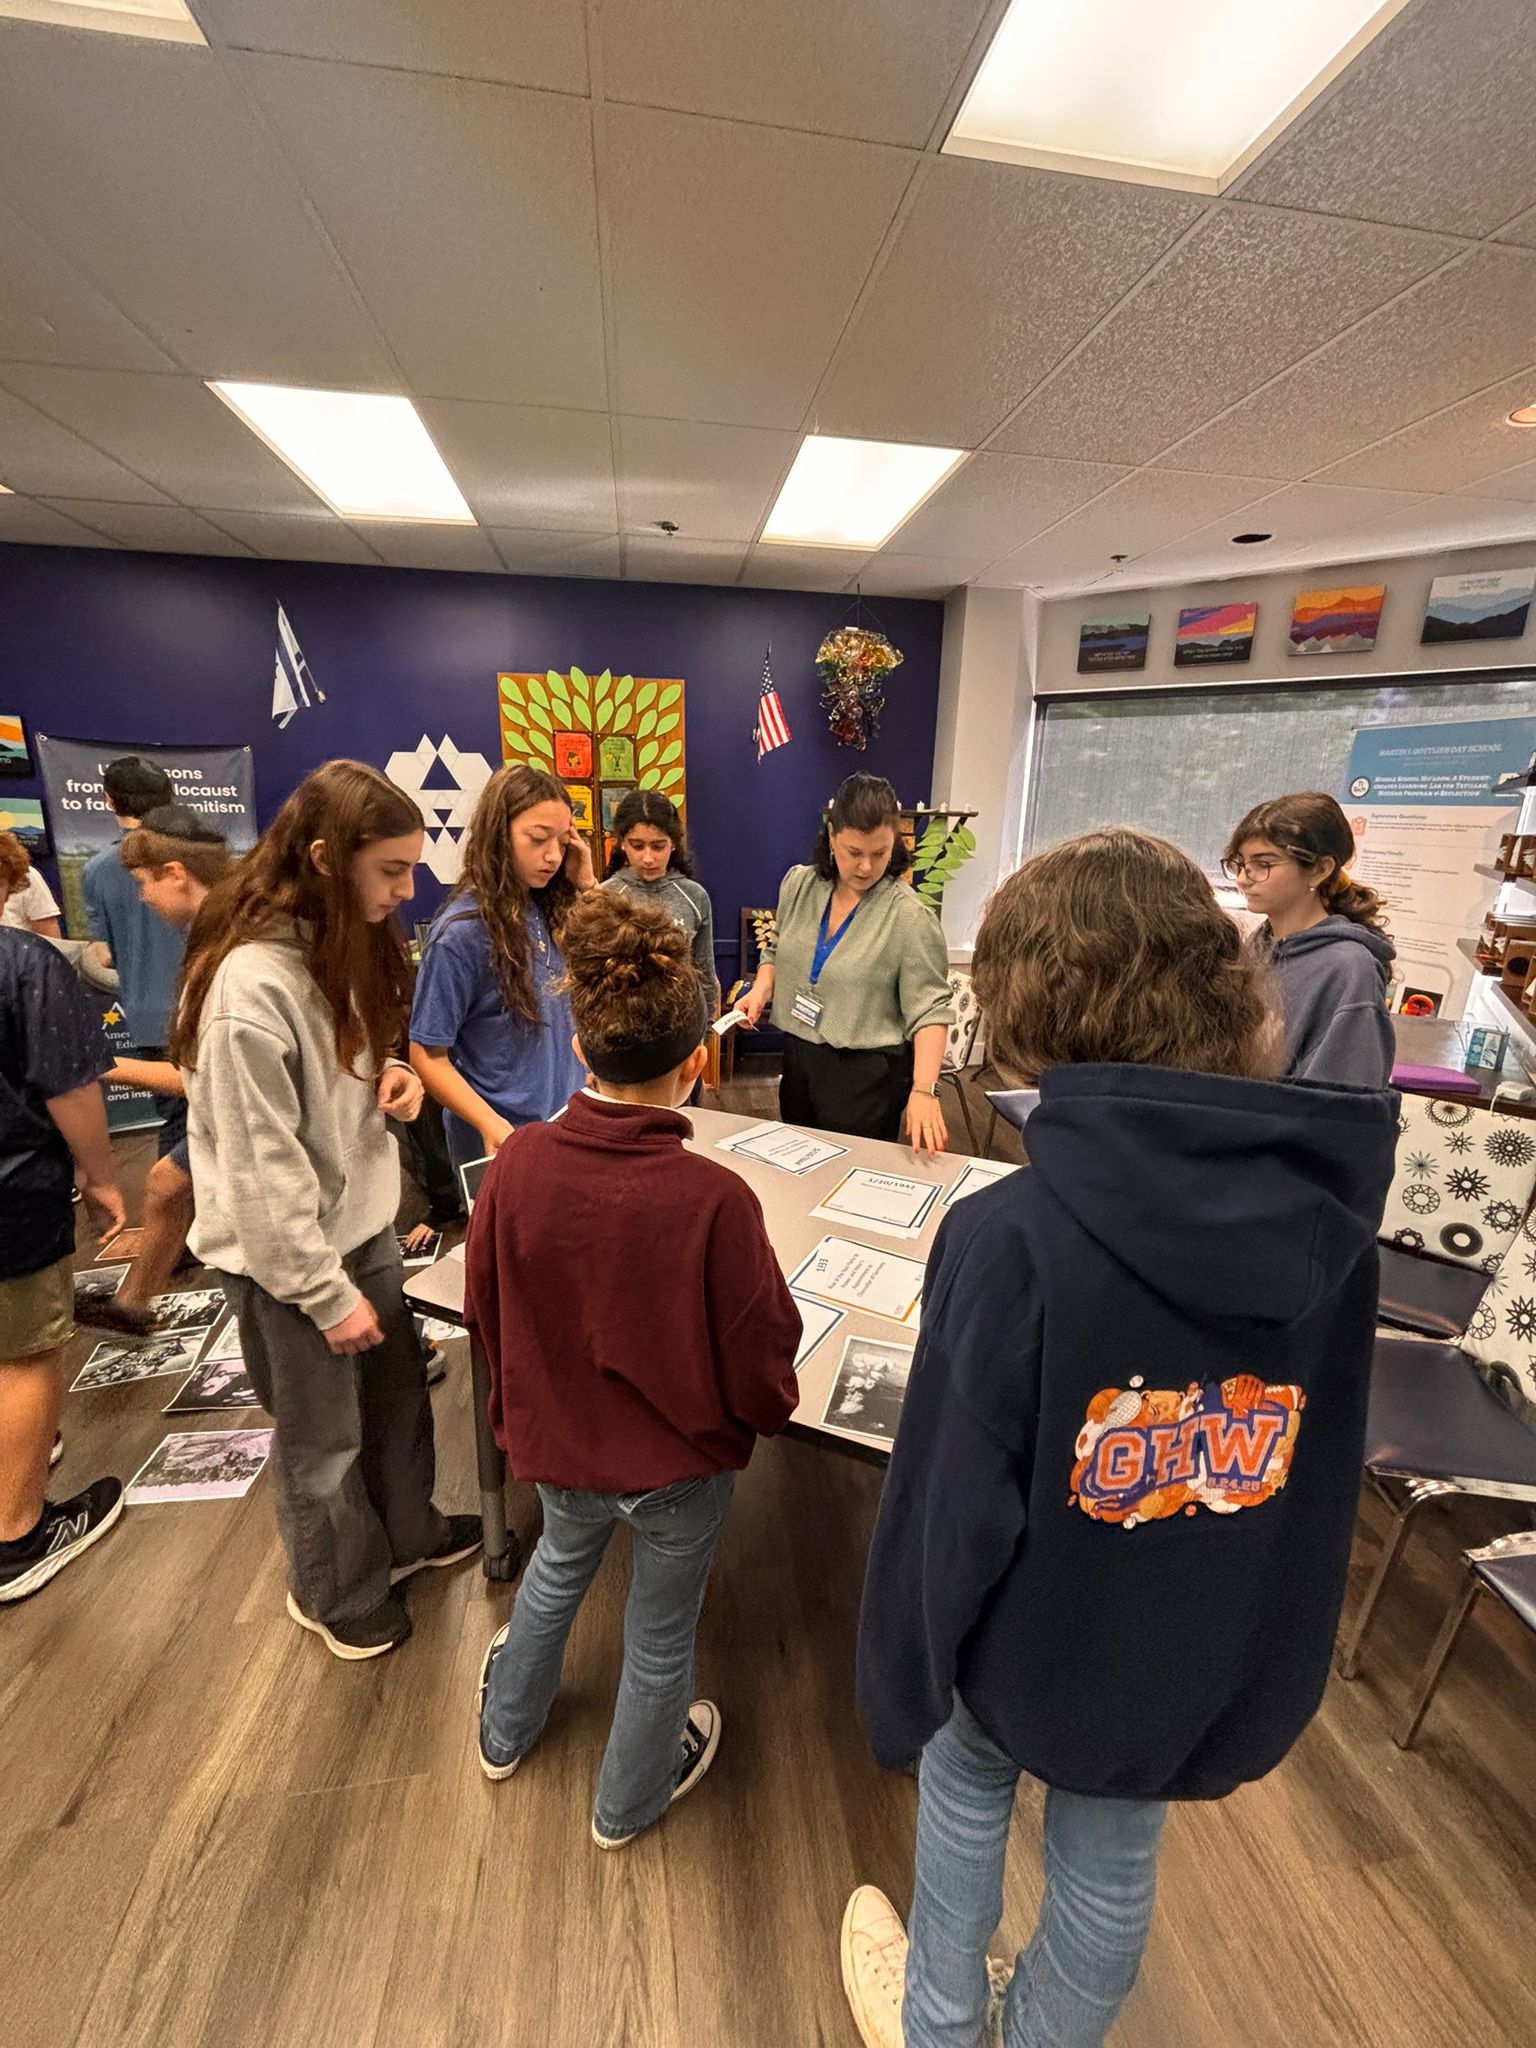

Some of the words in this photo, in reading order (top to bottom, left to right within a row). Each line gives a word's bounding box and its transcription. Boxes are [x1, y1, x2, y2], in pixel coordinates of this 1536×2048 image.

[1467, 743, 1502, 753] SCHOOL
[174, 783, 238, 797] locaust
[61, 797, 82, 811] to
[107, 1091, 130, 1102] and
[1095, 1412, 1284, 1490] GHW
